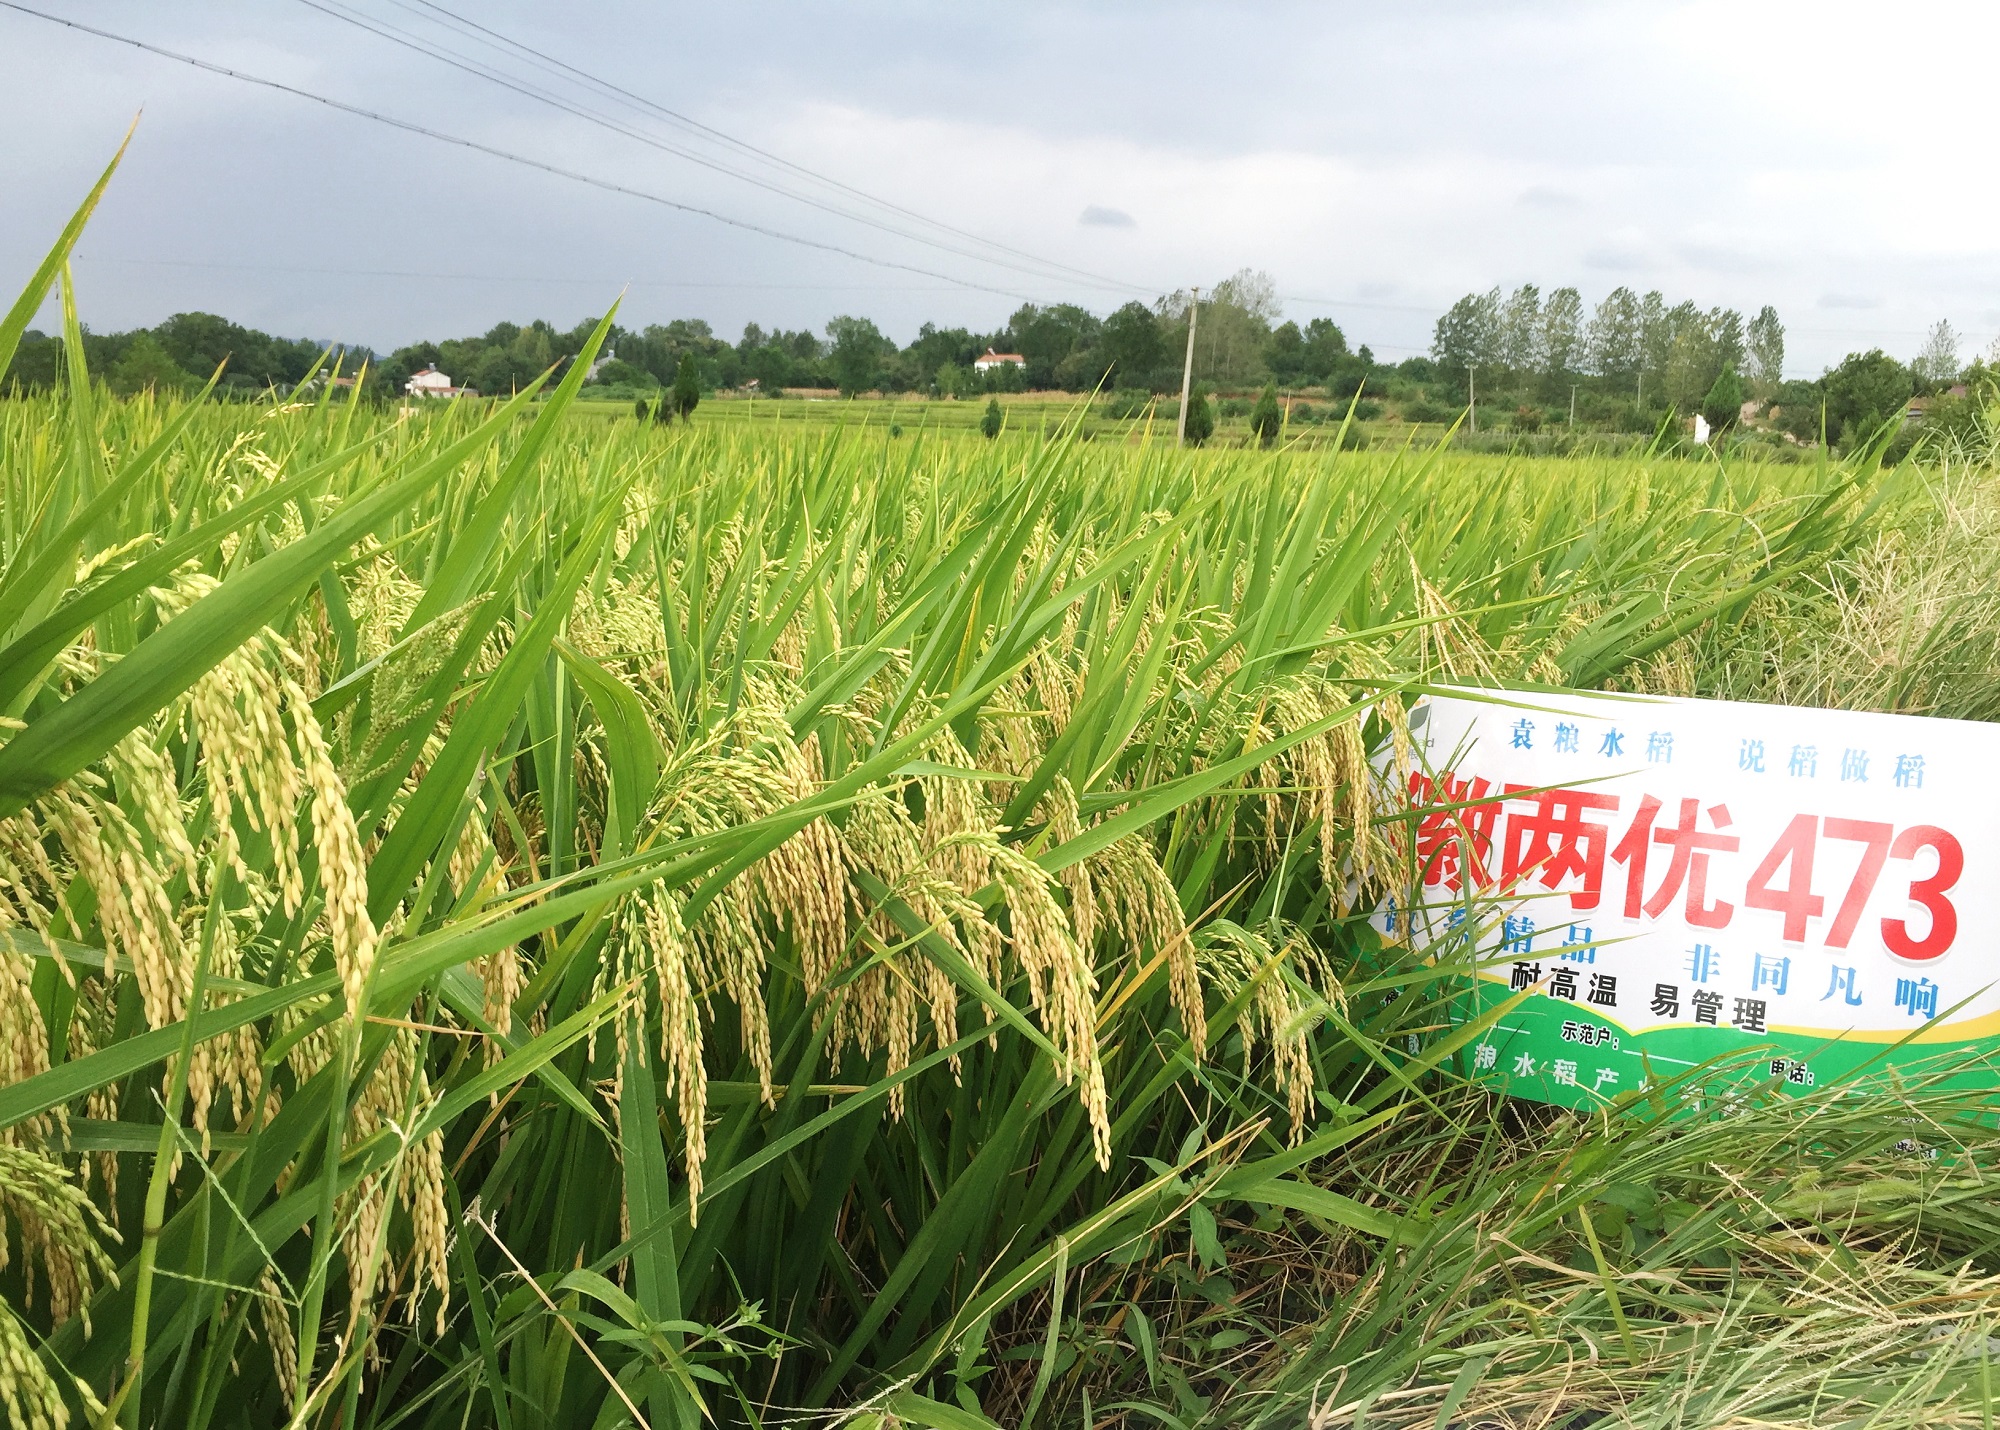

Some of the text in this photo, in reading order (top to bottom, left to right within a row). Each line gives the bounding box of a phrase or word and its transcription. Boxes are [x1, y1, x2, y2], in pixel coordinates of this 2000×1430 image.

[1507, 717, 1926, 789] 袁粮水稻 说稻做稻
[1509, 961, 1767, 1034] 耐高温 易管理
[1682, 943, 1939, 1020] 非同凡响
